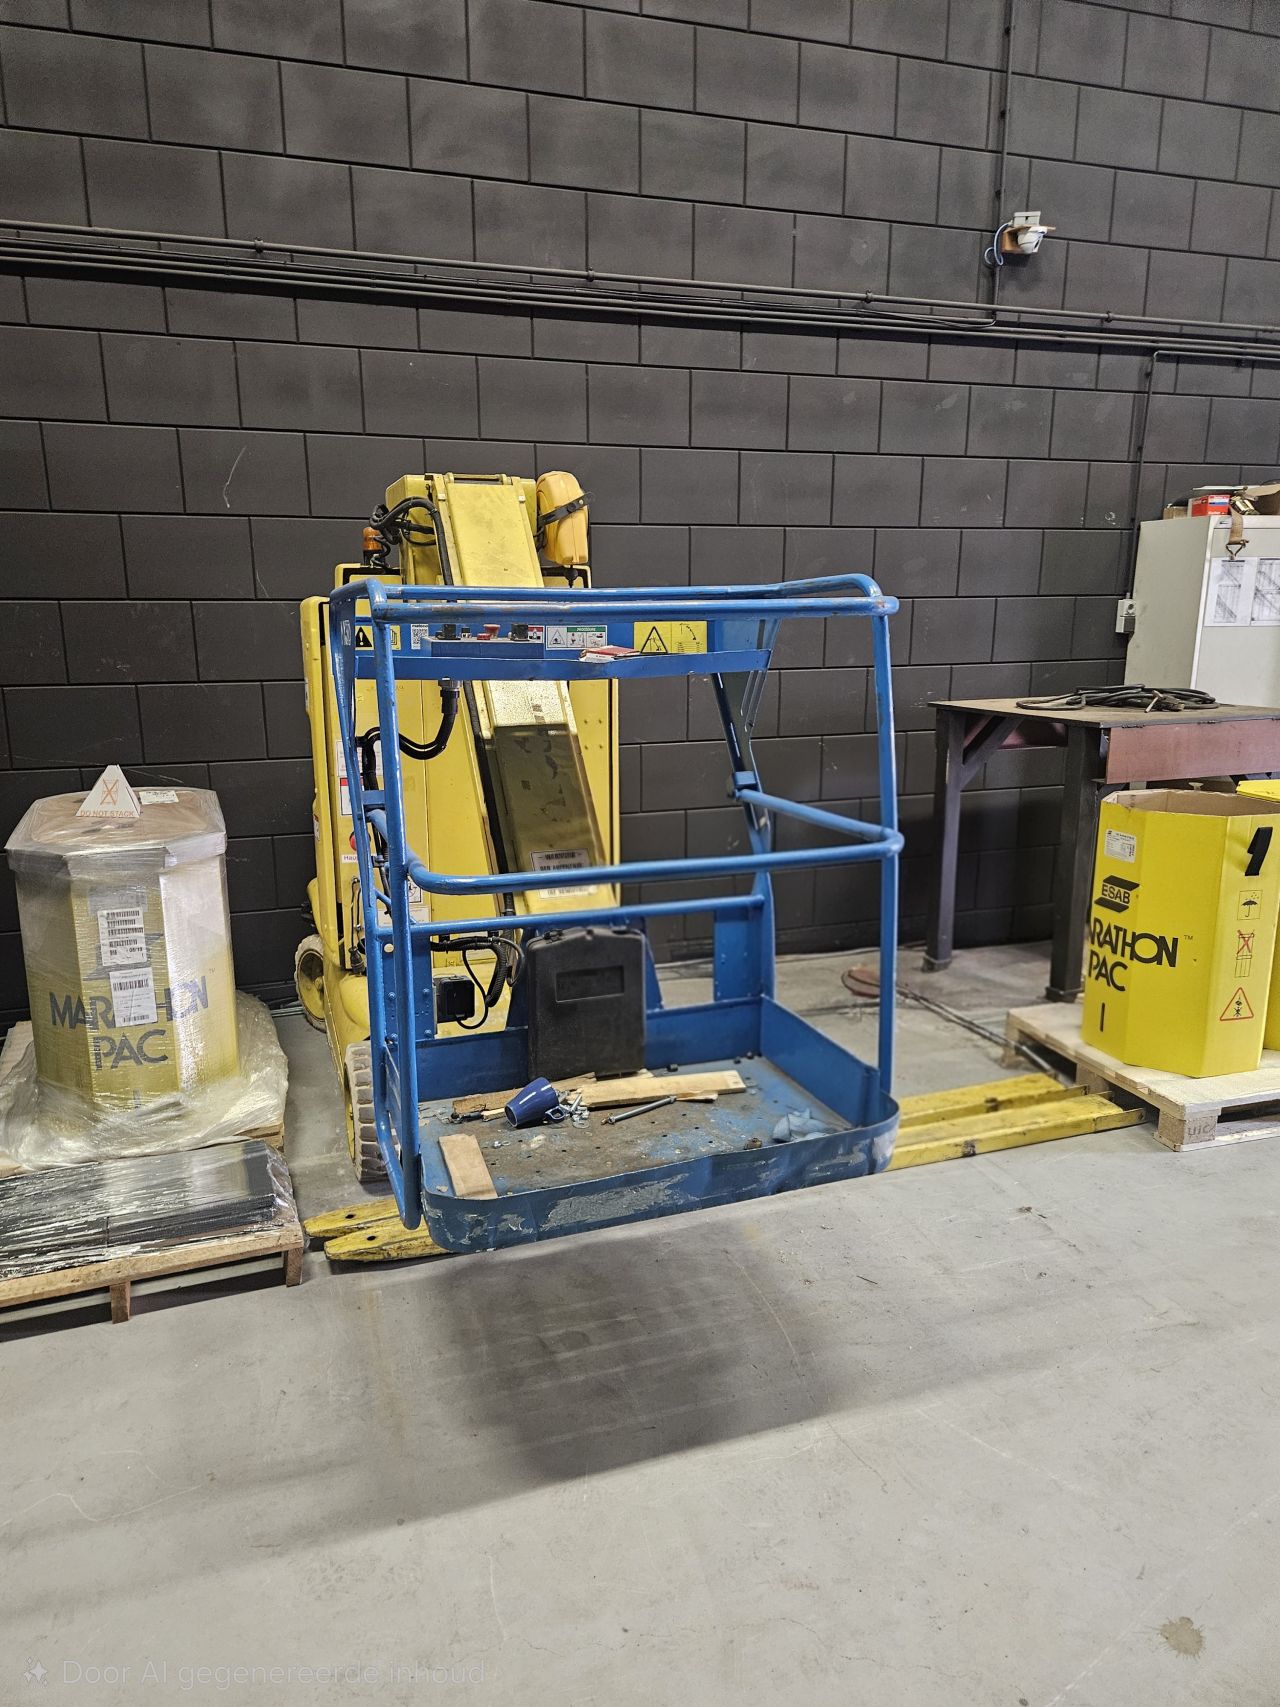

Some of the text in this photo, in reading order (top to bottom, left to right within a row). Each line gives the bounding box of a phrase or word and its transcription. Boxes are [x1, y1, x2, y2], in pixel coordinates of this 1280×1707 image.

[1102, 882, 1131, 905] ESAB
[1088, 949, 1128, 992] PAC
[50, 975, 209, 1030] MARHON
[93, 1029, 169, 1071] PAC
